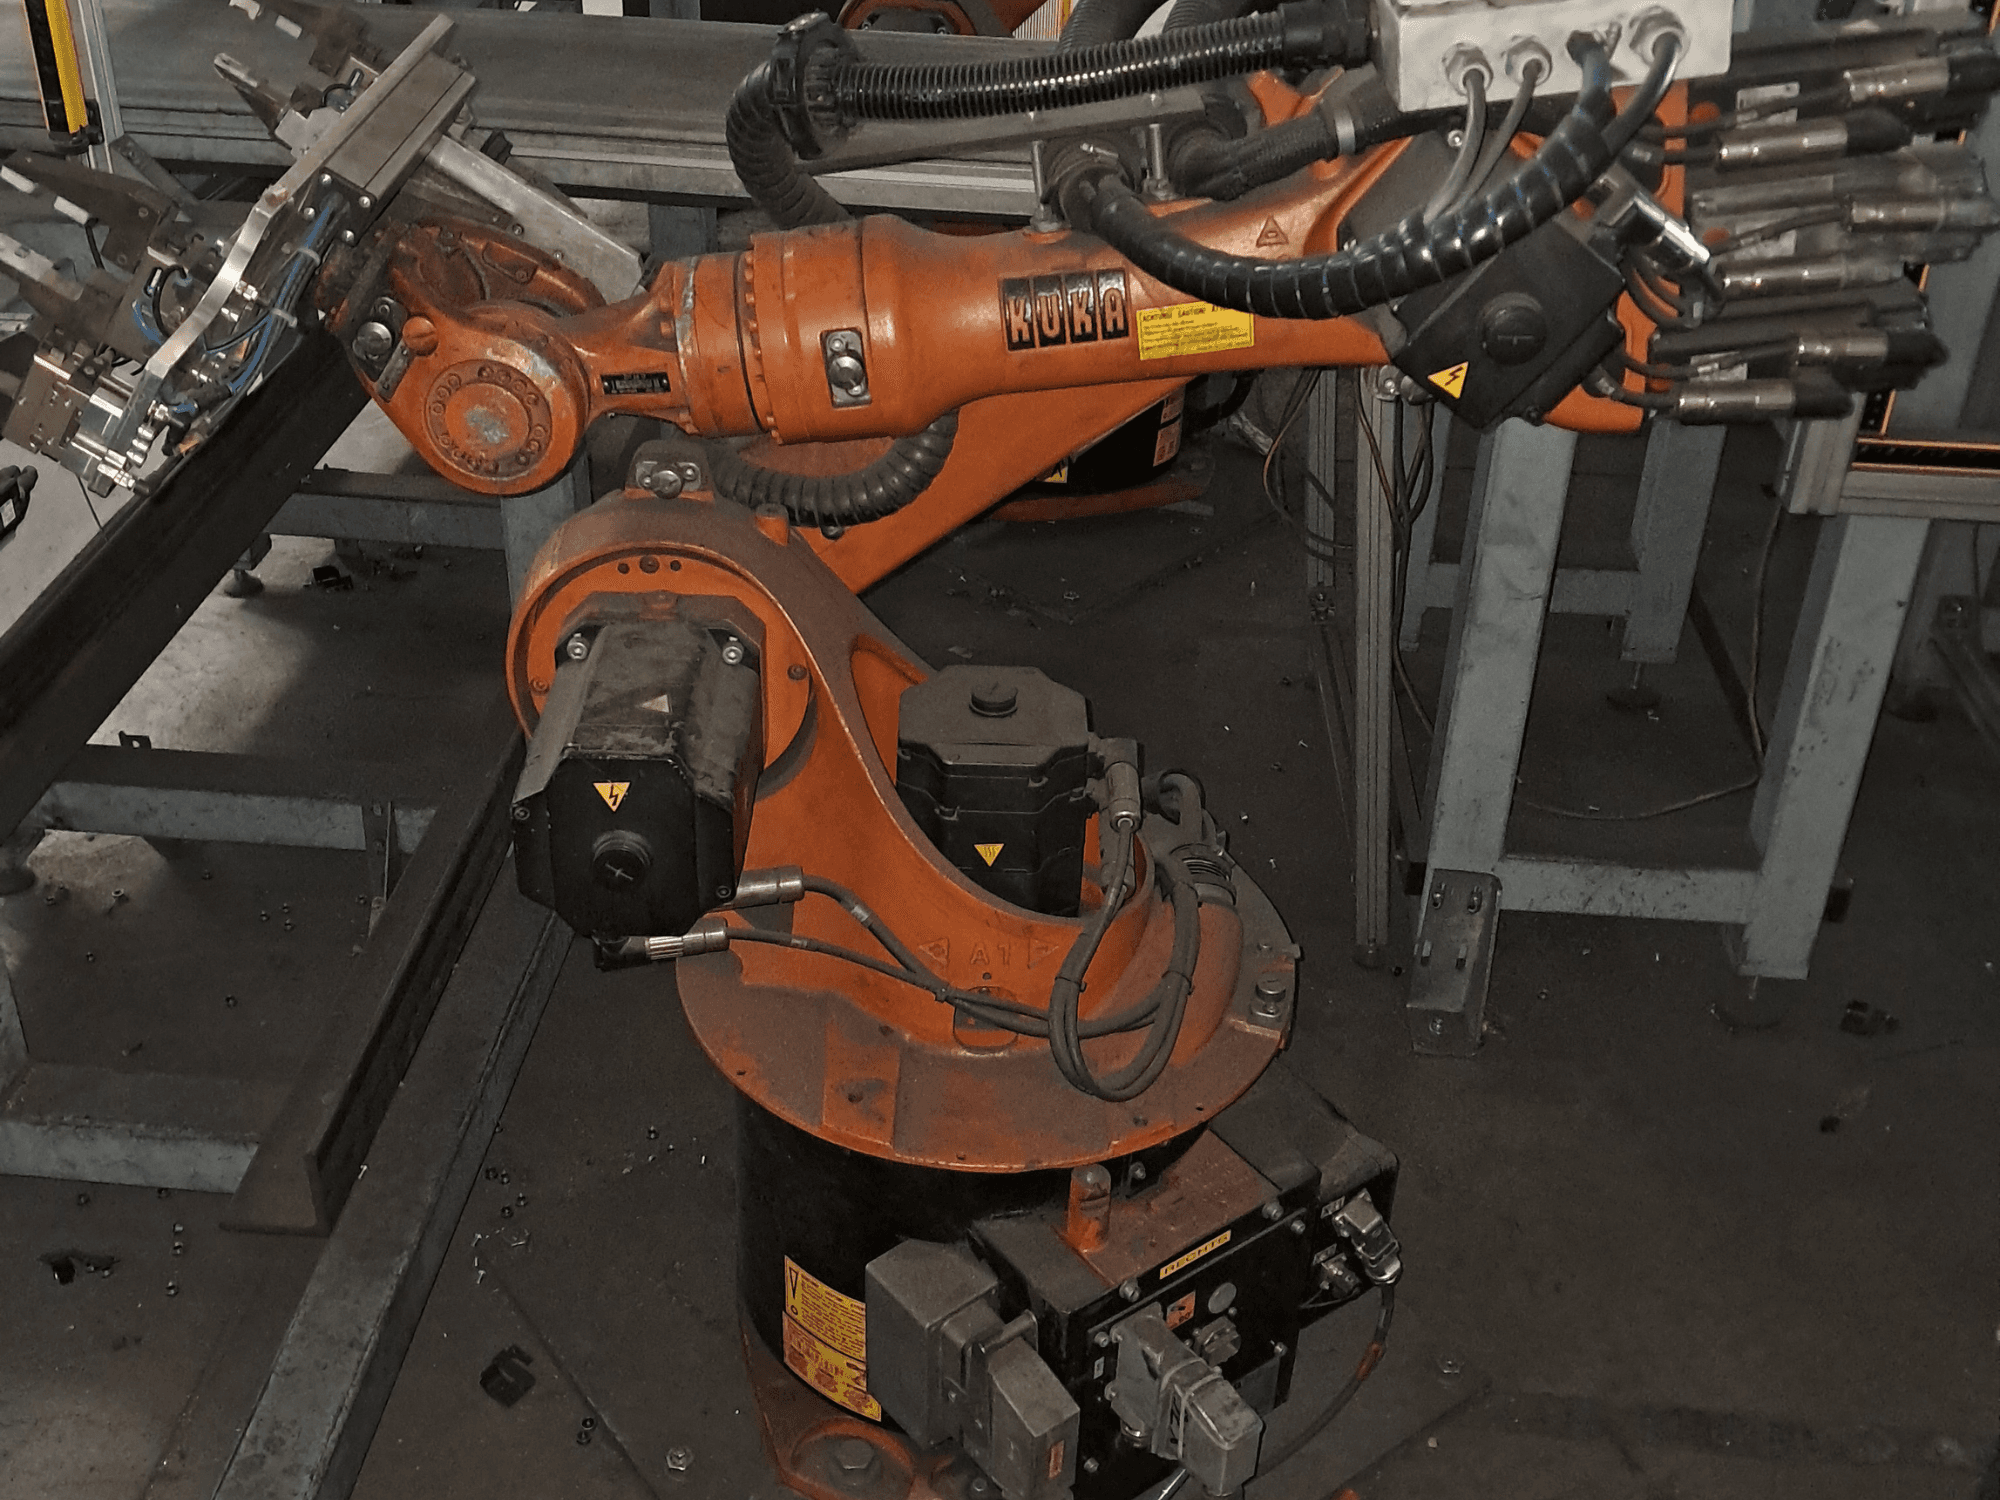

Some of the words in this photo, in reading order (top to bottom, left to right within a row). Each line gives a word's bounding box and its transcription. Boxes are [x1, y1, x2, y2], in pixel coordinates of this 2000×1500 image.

[1006, 285, 1126, 345] KUKA
[970, 942, 1011, 966] A1
[1164, 1233, 1228, 1276] RECHTS
